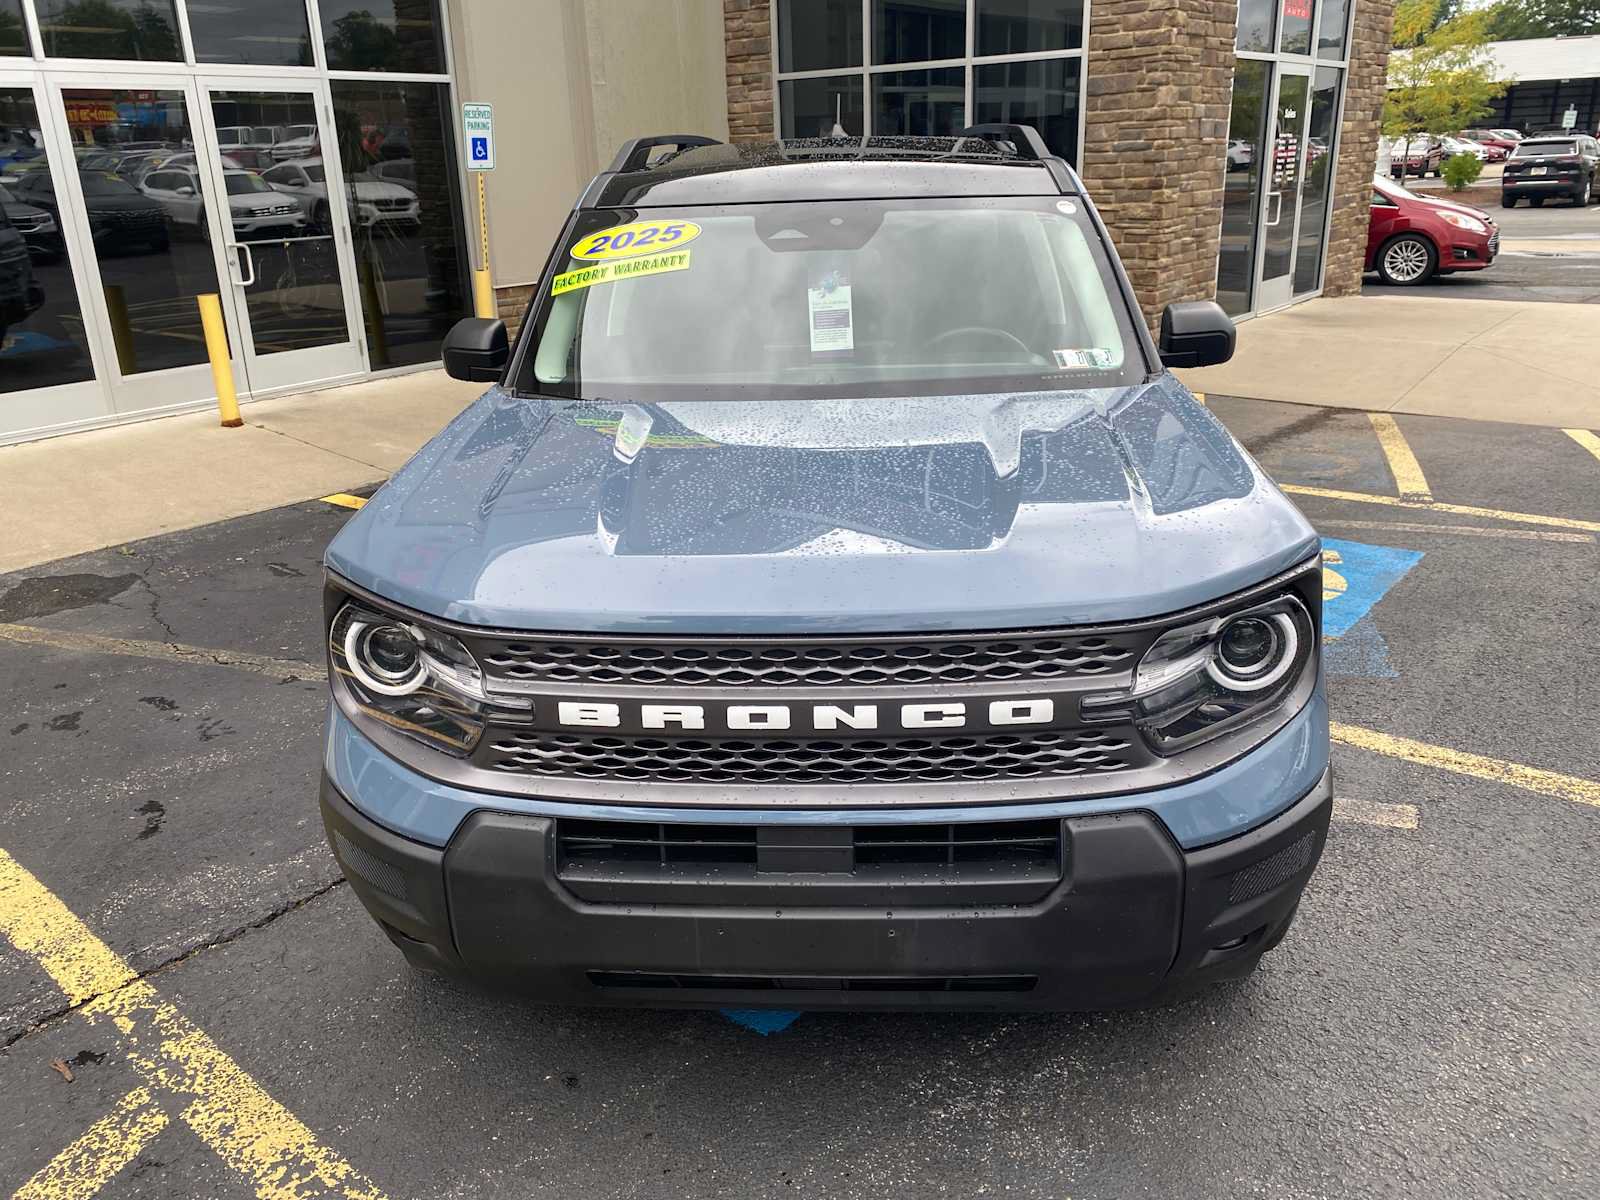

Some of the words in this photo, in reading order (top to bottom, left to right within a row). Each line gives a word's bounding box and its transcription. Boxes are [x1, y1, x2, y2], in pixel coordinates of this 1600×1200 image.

[464, 110, 490, 119] RESERVED
[467, 121, 490, 130] PARKING
[584, 224, 687, 256] 2025
[554, 268, 608, 290] FACTORY
[613, 254, 687, 275] WARRANTY
[557, 698, 1055, 730] BRONCO
